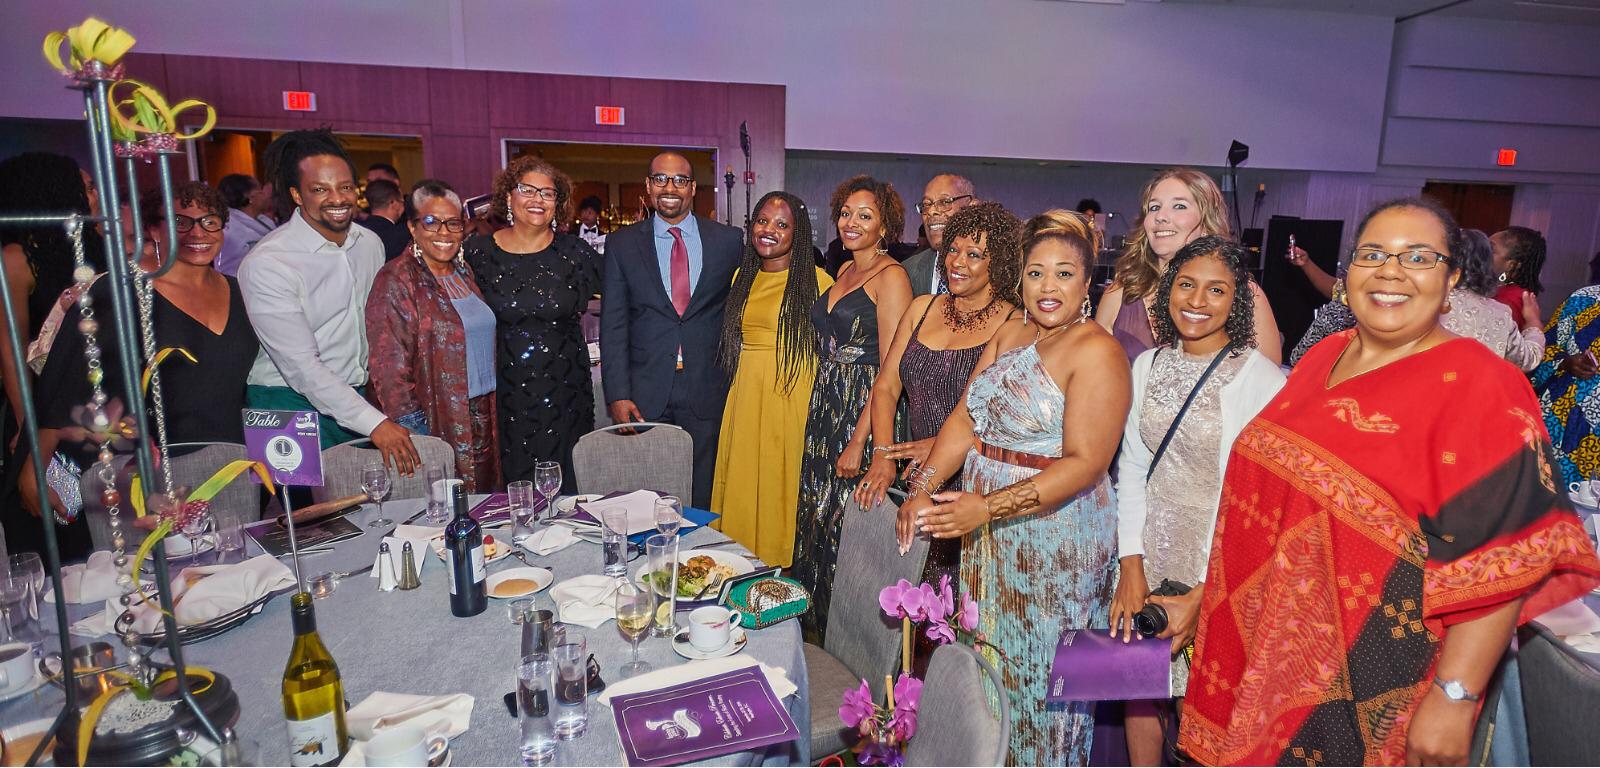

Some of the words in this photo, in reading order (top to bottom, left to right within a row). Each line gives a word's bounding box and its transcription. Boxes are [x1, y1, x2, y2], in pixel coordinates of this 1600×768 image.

[289, 92, 310, 109] EXIT
[601, 107, 620, 123] EXIT
[245, 410, 281, 427] Table
